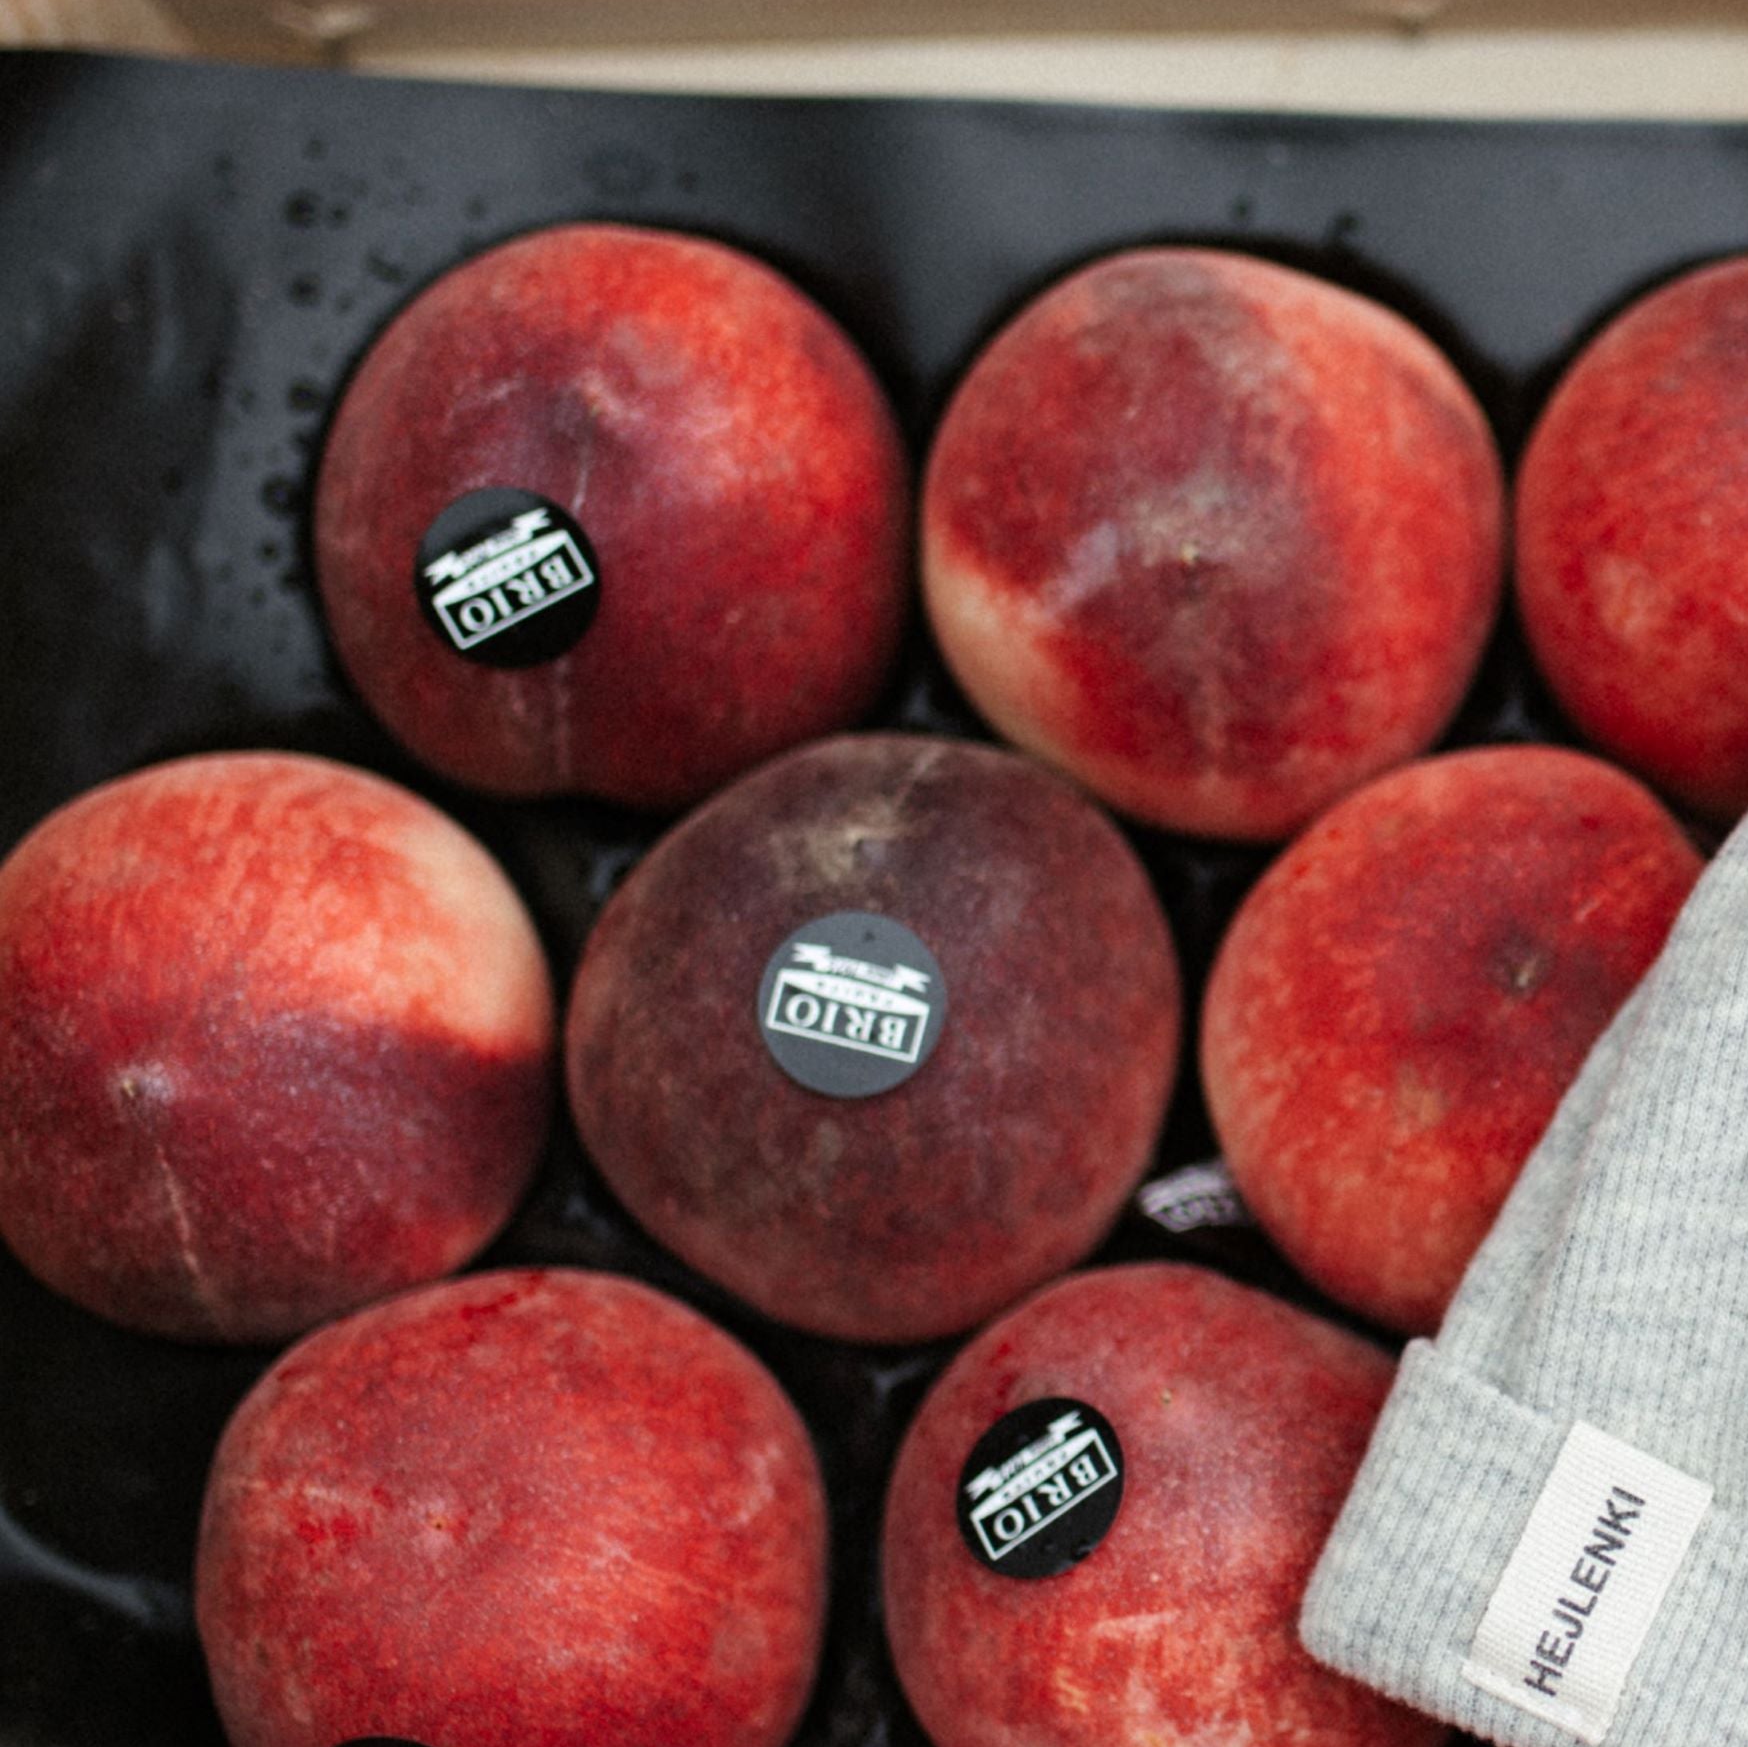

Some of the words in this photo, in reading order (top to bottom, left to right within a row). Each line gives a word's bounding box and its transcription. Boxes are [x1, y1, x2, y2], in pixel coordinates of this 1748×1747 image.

[459, 559, 576, 634] BRIO
[785, 993, 908, 1050] BRIO
[992, 1454, 1100, 1541] BRIO
[1523, 1486, 1645, 1697] HEJLENKI
